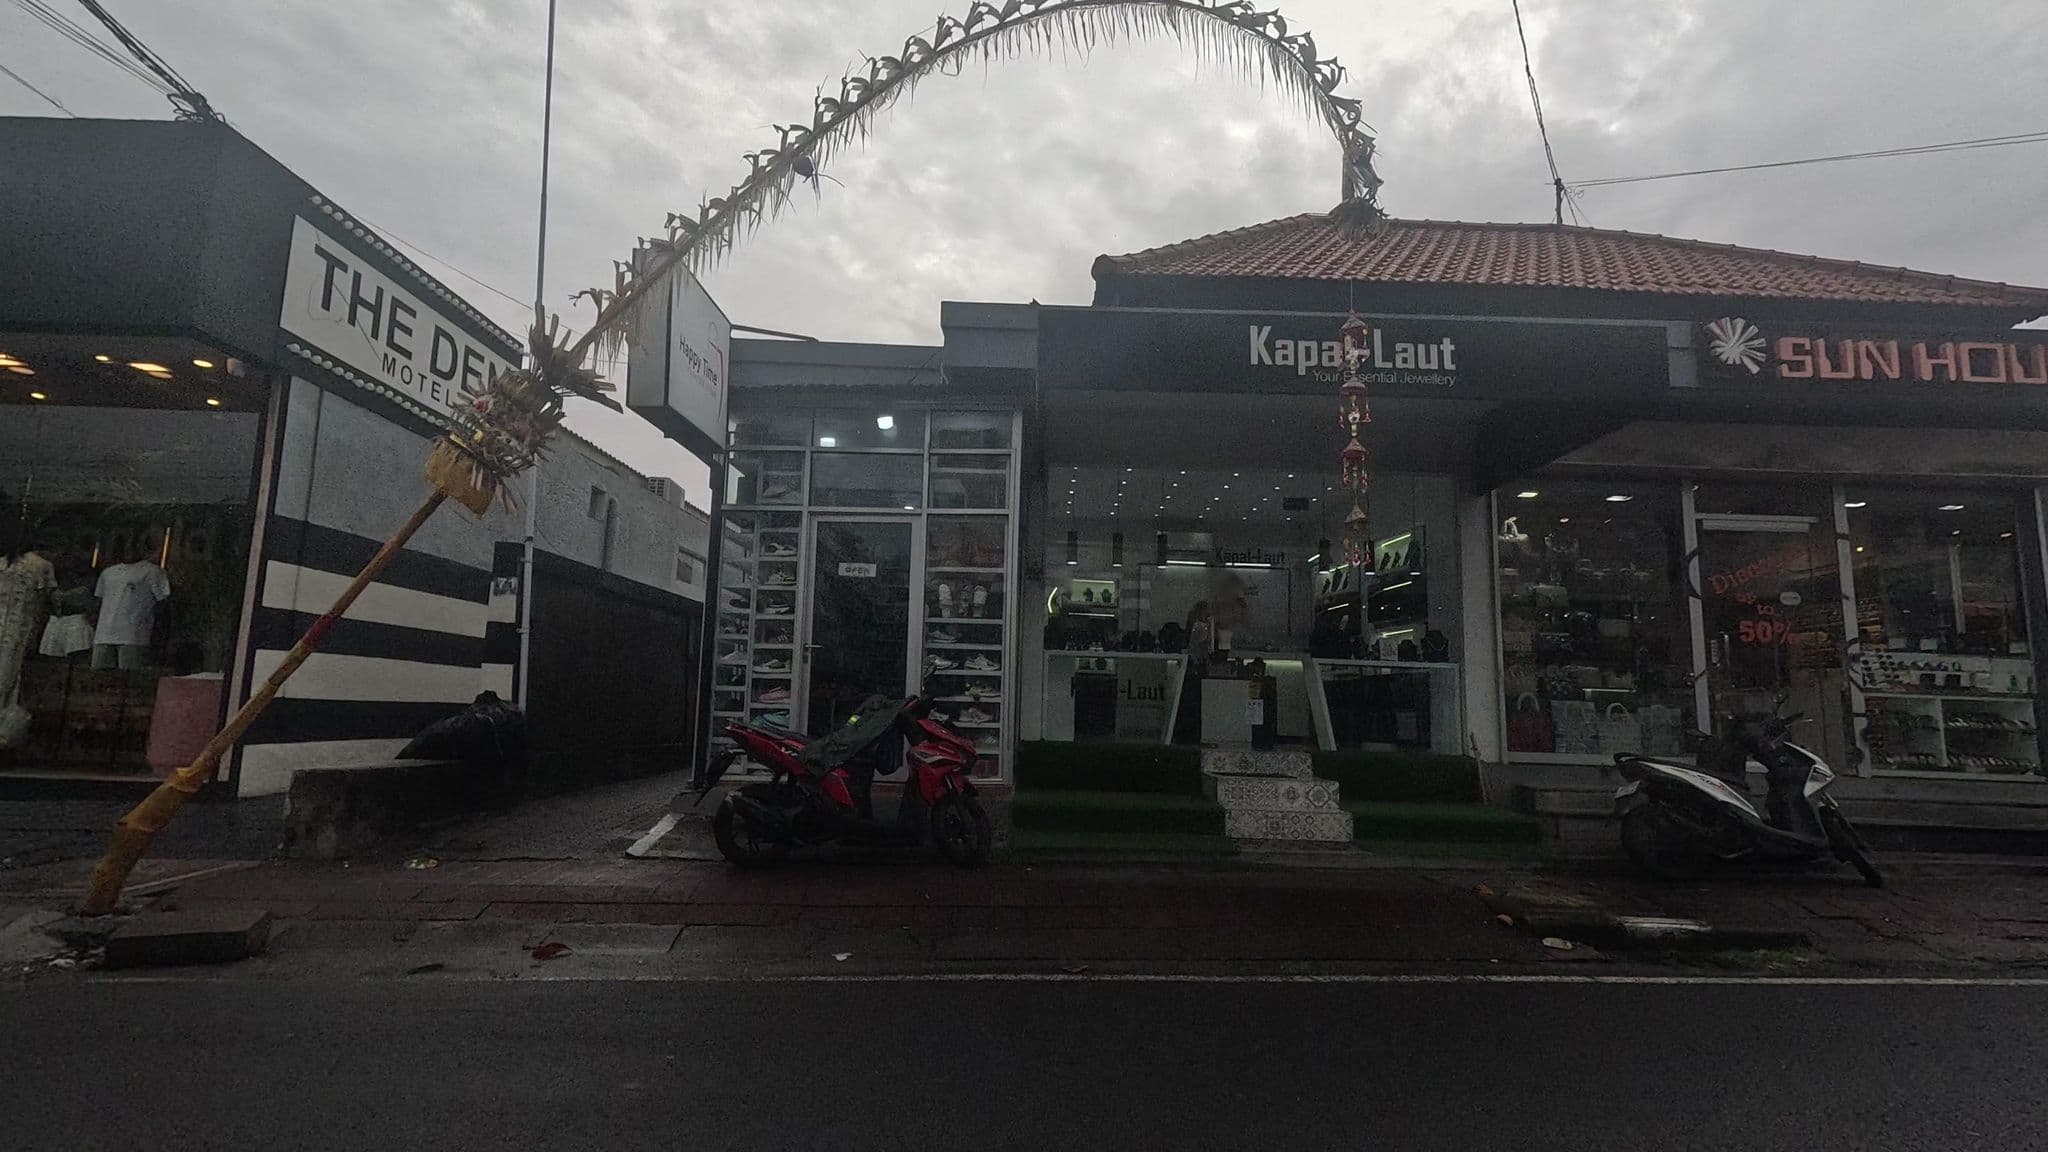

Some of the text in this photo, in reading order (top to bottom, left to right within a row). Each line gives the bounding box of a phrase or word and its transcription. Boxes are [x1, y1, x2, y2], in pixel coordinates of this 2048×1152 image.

[314, 244, 417, 360] THE
[680, 335, 702, 373] Happy
[703, 357, 718, 386] Time
[1250, 325, 1457, 376] Kapa-Laut
[1775, 337, 1900, 381] SUN
[382, 355, 458, 409] MOTEL
[1312, 369, 1457, 388] Your Esential Jewellery
